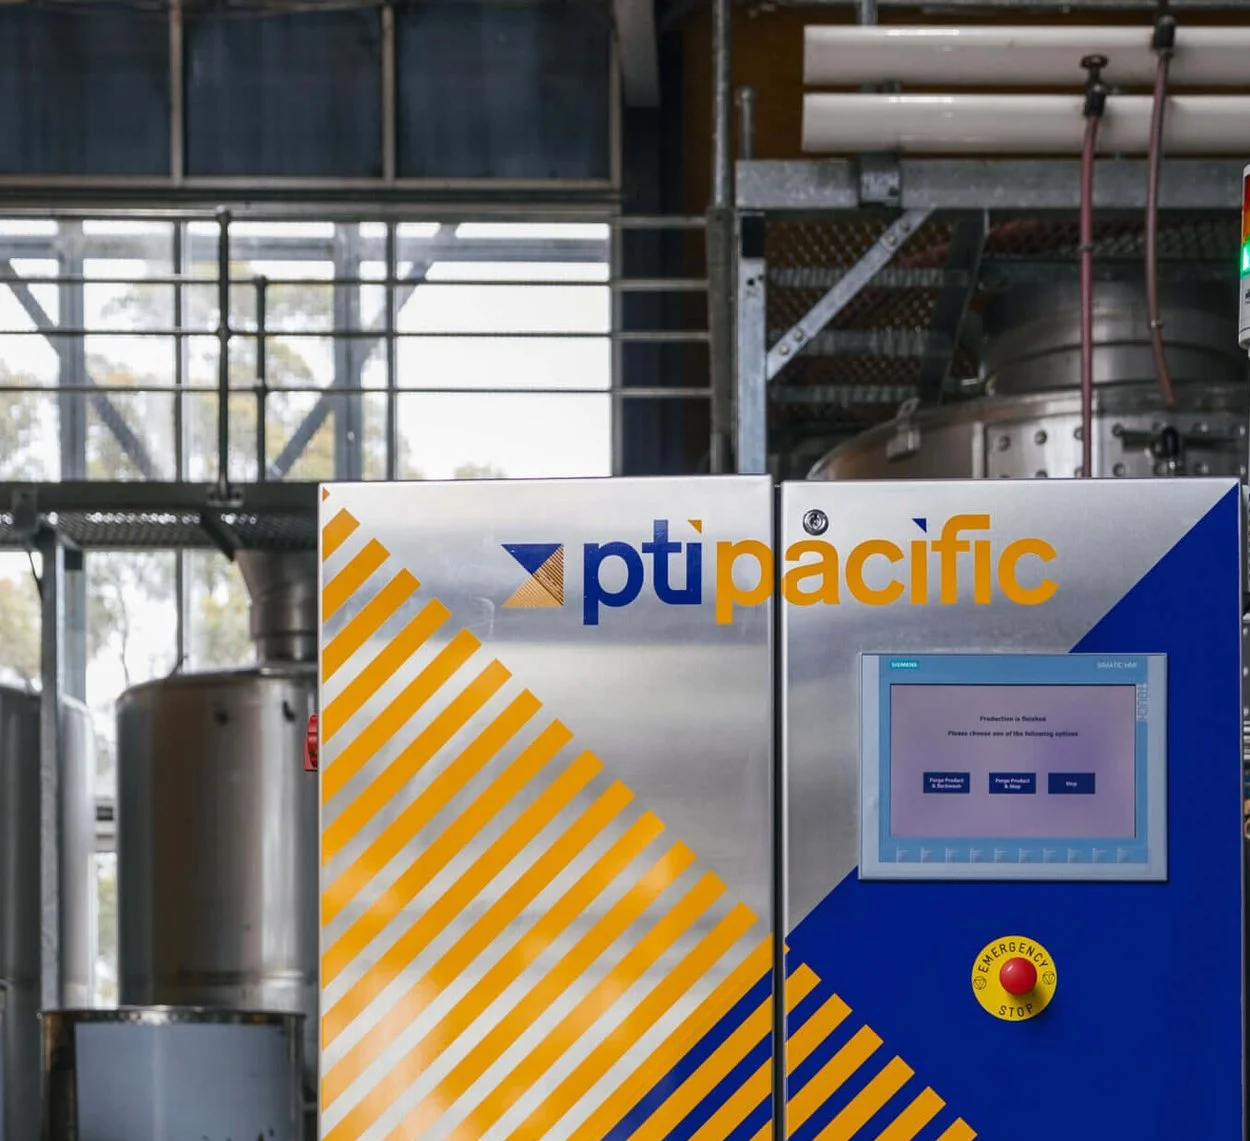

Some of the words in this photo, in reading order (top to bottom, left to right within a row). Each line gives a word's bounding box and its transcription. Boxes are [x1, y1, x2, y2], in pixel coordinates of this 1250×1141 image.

[583, 519, 703, 626] pti
[715, 514, 1058, 625] pacific
[1025, 730, 1053, 738] following
[1055, 730, 1078, 738] options
[977, 941, 1049, 974] EMERGENCY
[998, 1003, 1033, 1018] STOP
